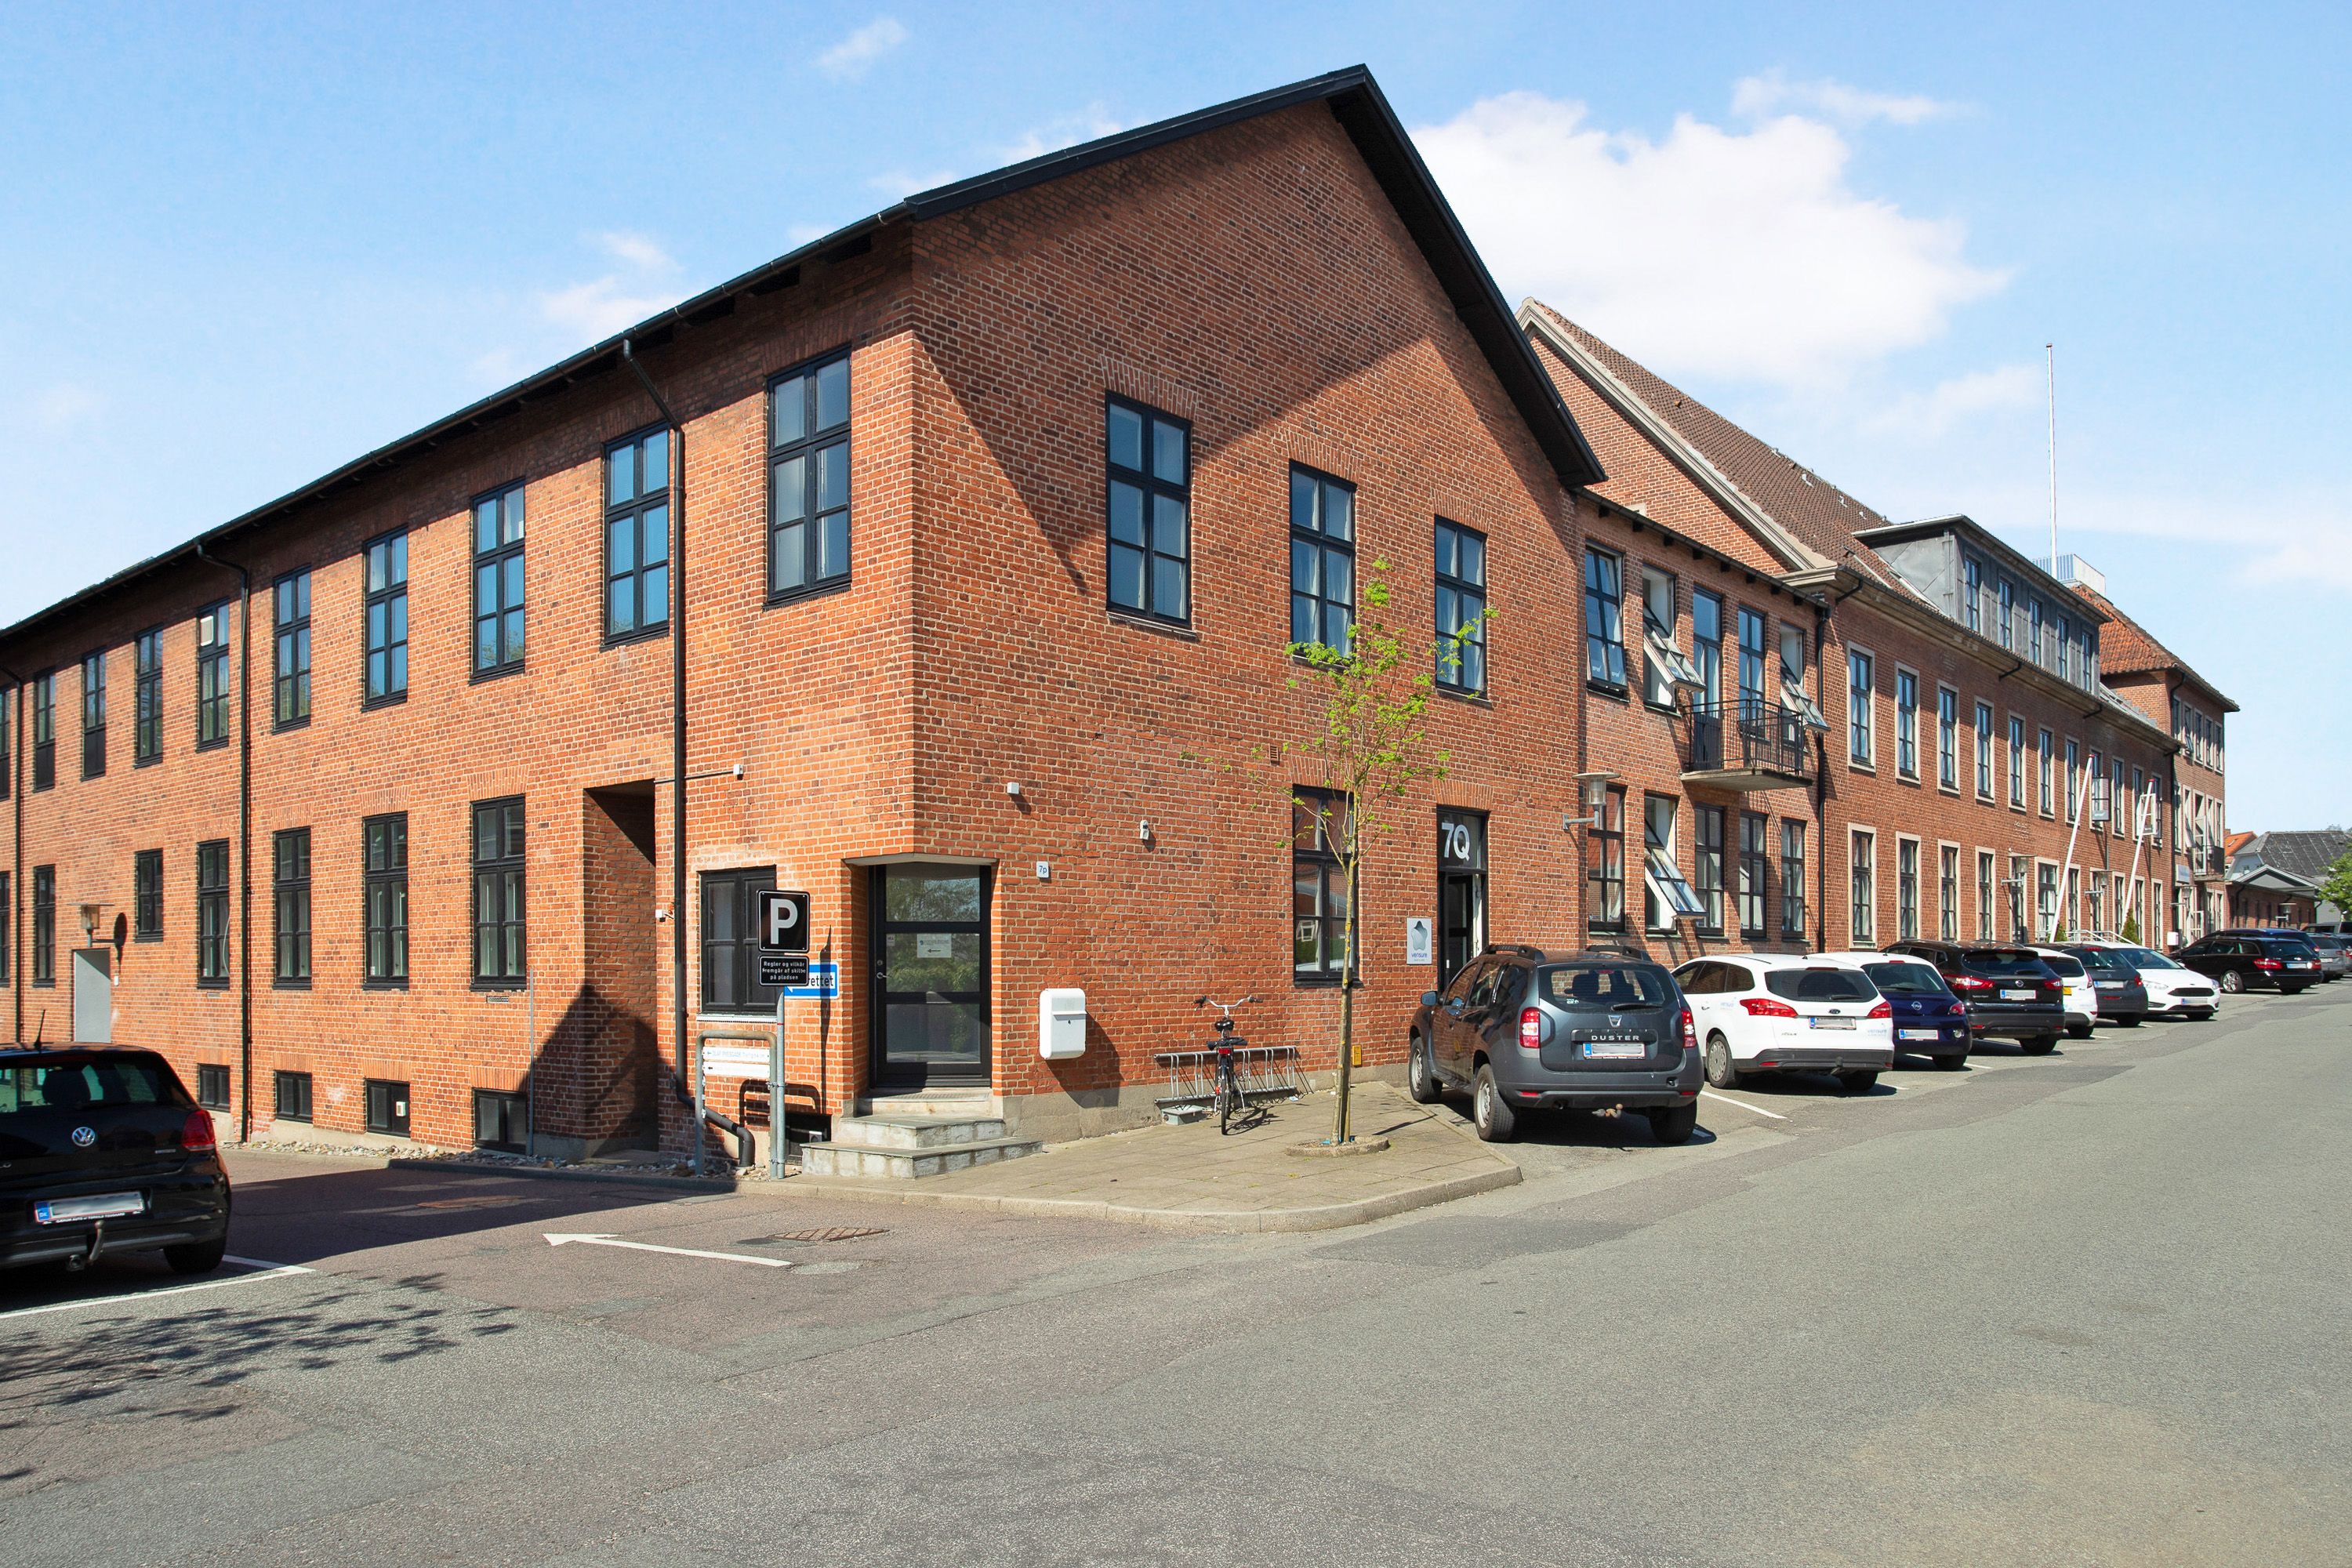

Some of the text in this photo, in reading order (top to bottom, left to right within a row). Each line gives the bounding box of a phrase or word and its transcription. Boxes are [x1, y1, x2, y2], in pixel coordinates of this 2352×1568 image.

[1442, 822, 1470, 861] 7Q
[1039, 866, 1047, 874] 7p
[771, 898, 798, 945] P
